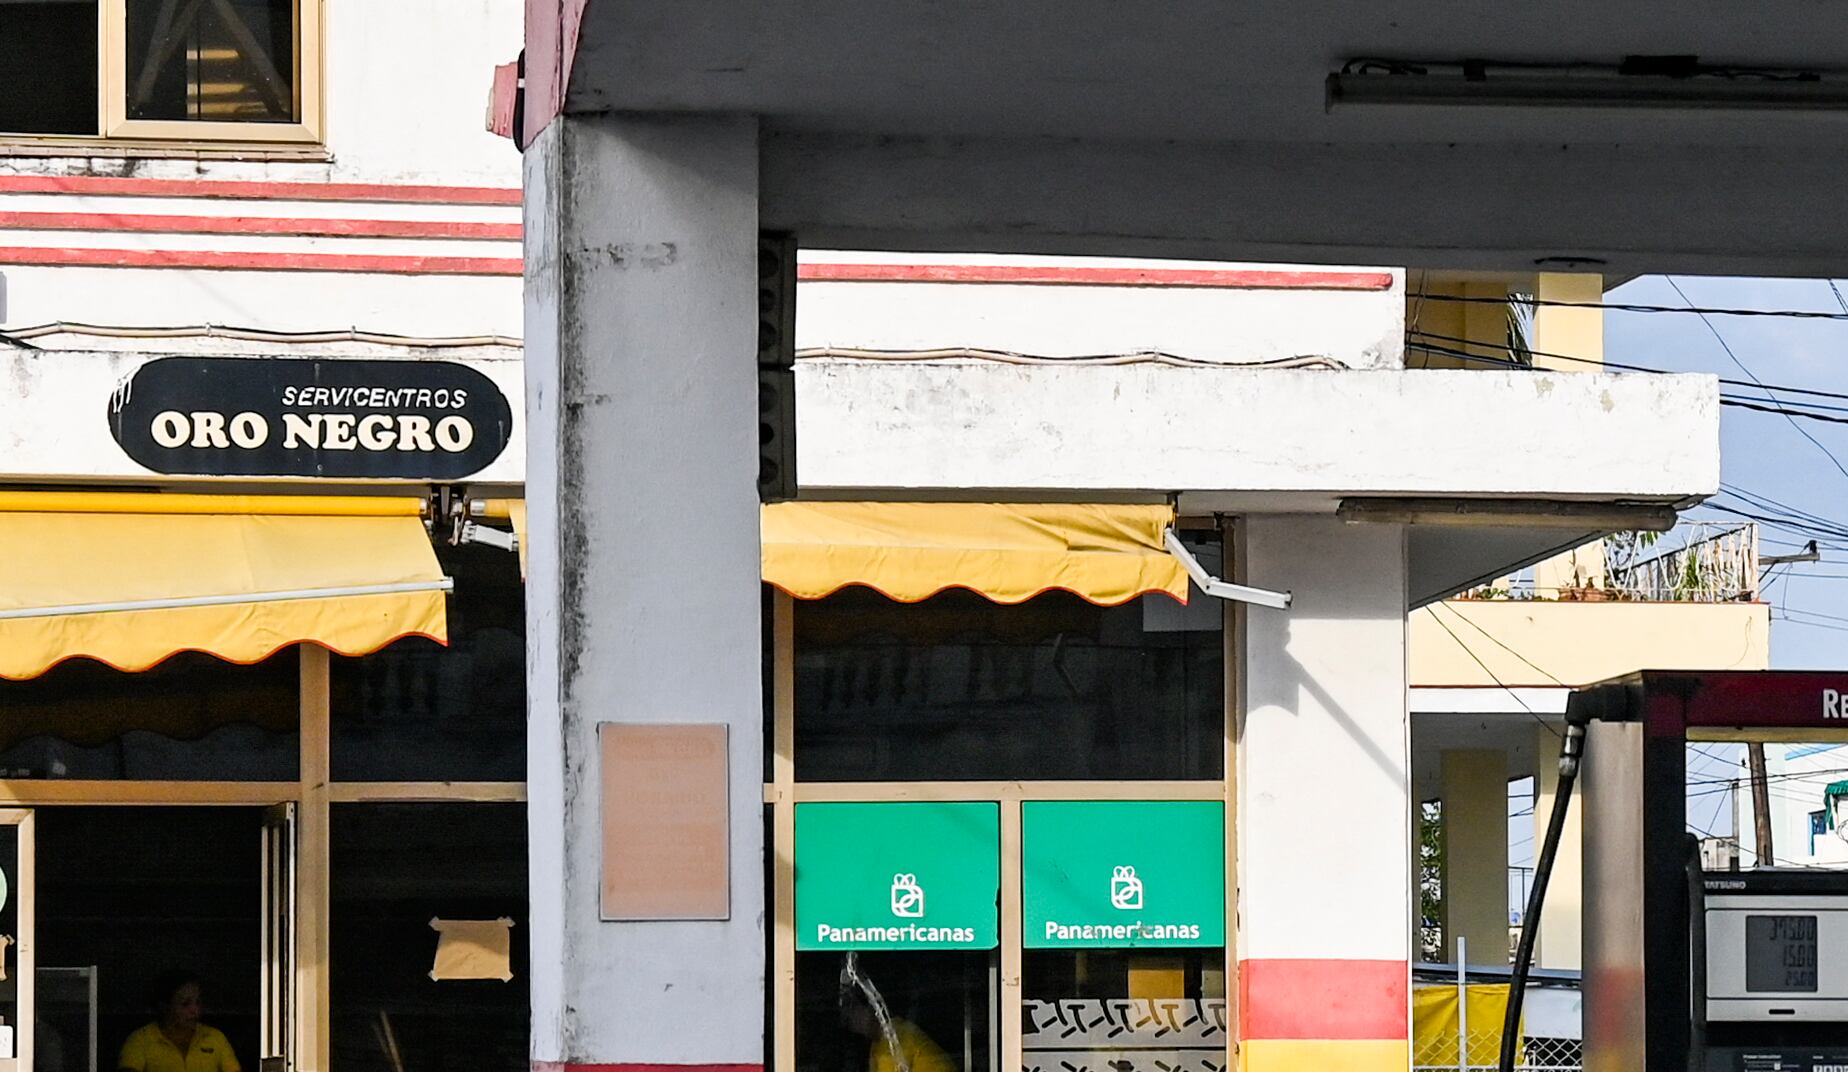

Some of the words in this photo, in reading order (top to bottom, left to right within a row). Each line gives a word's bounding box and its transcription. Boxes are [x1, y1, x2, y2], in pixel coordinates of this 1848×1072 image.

[281, 386, 469, 410] SERVICENTROS
[150, 410, 269, 450] ORO
[283, 412, 475, 454] NEGRO
[816, 922, 975, 944] Panamericanas
[1044, 920, 1200, 942] Panamericanas
